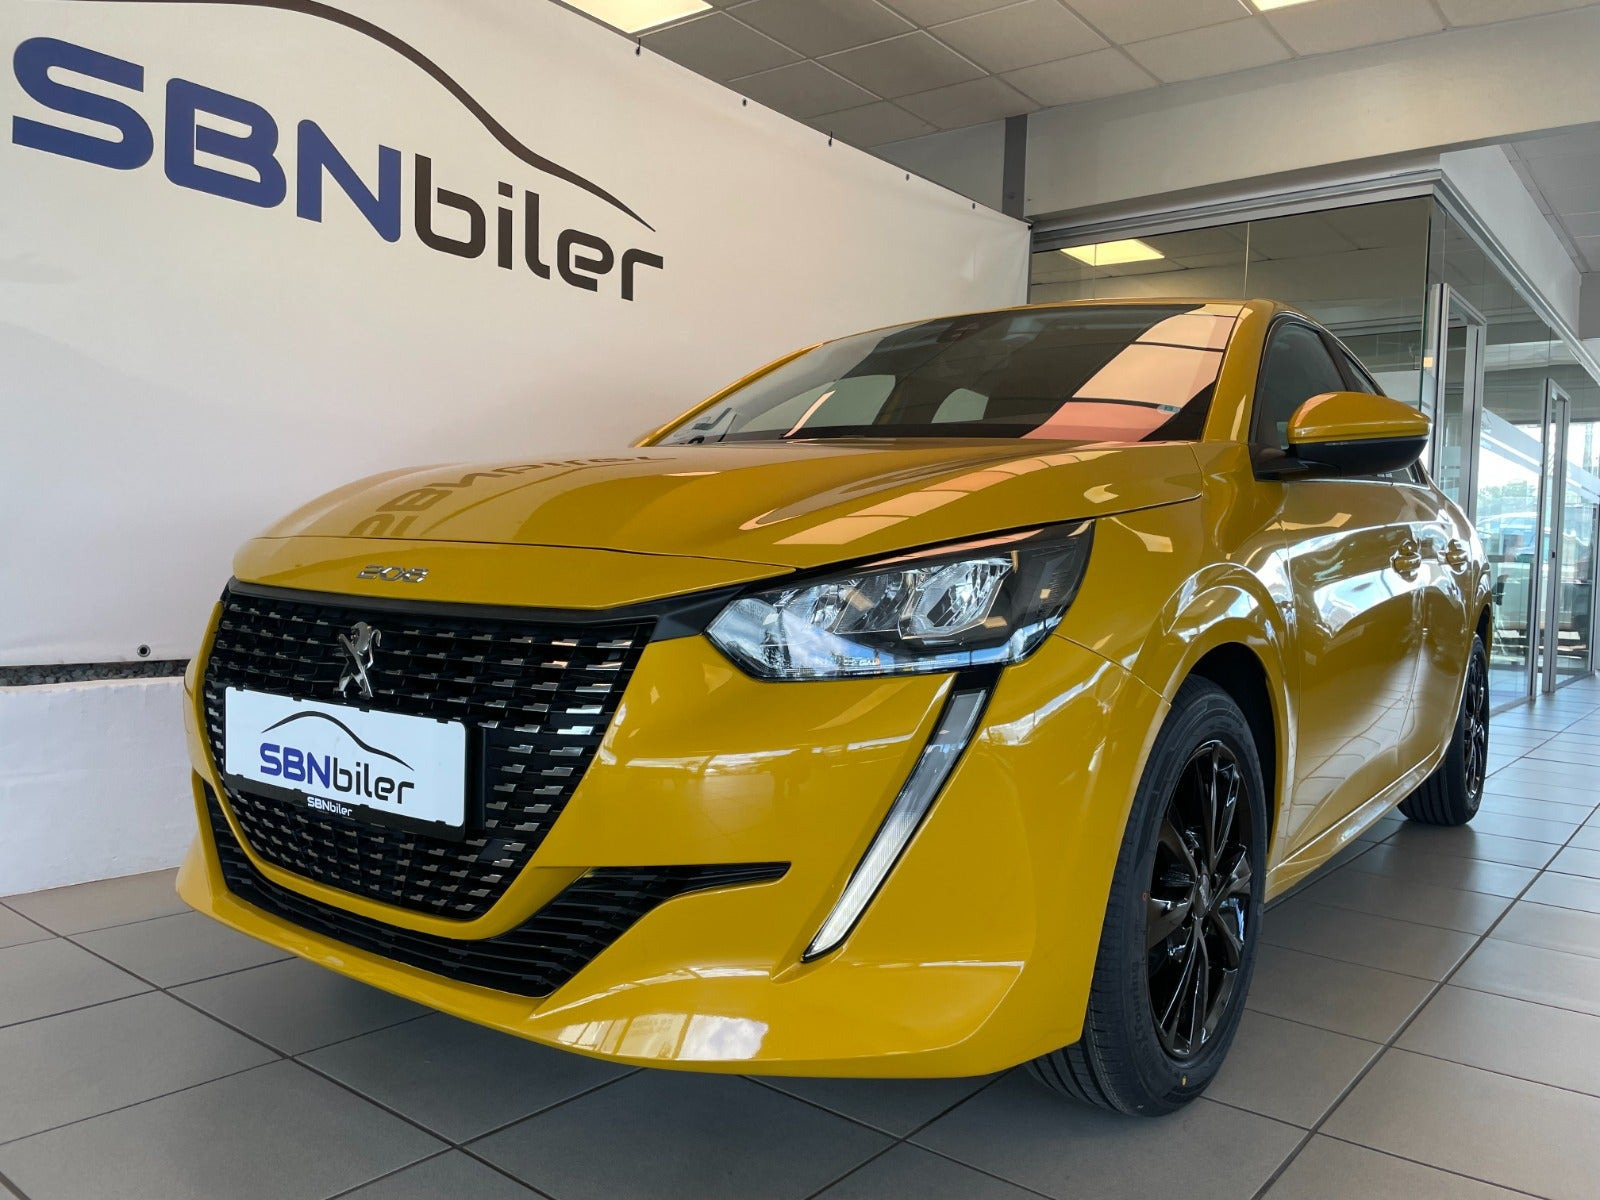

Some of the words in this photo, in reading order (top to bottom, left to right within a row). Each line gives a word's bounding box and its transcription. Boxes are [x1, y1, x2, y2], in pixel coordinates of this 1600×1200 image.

[12, 37, 664, 301] SBNbiler
[357, 565, 429, 584] 208
[260, 742, 415, 804] SBNbiler
[307, 797, 353, 817] SBNbiler
